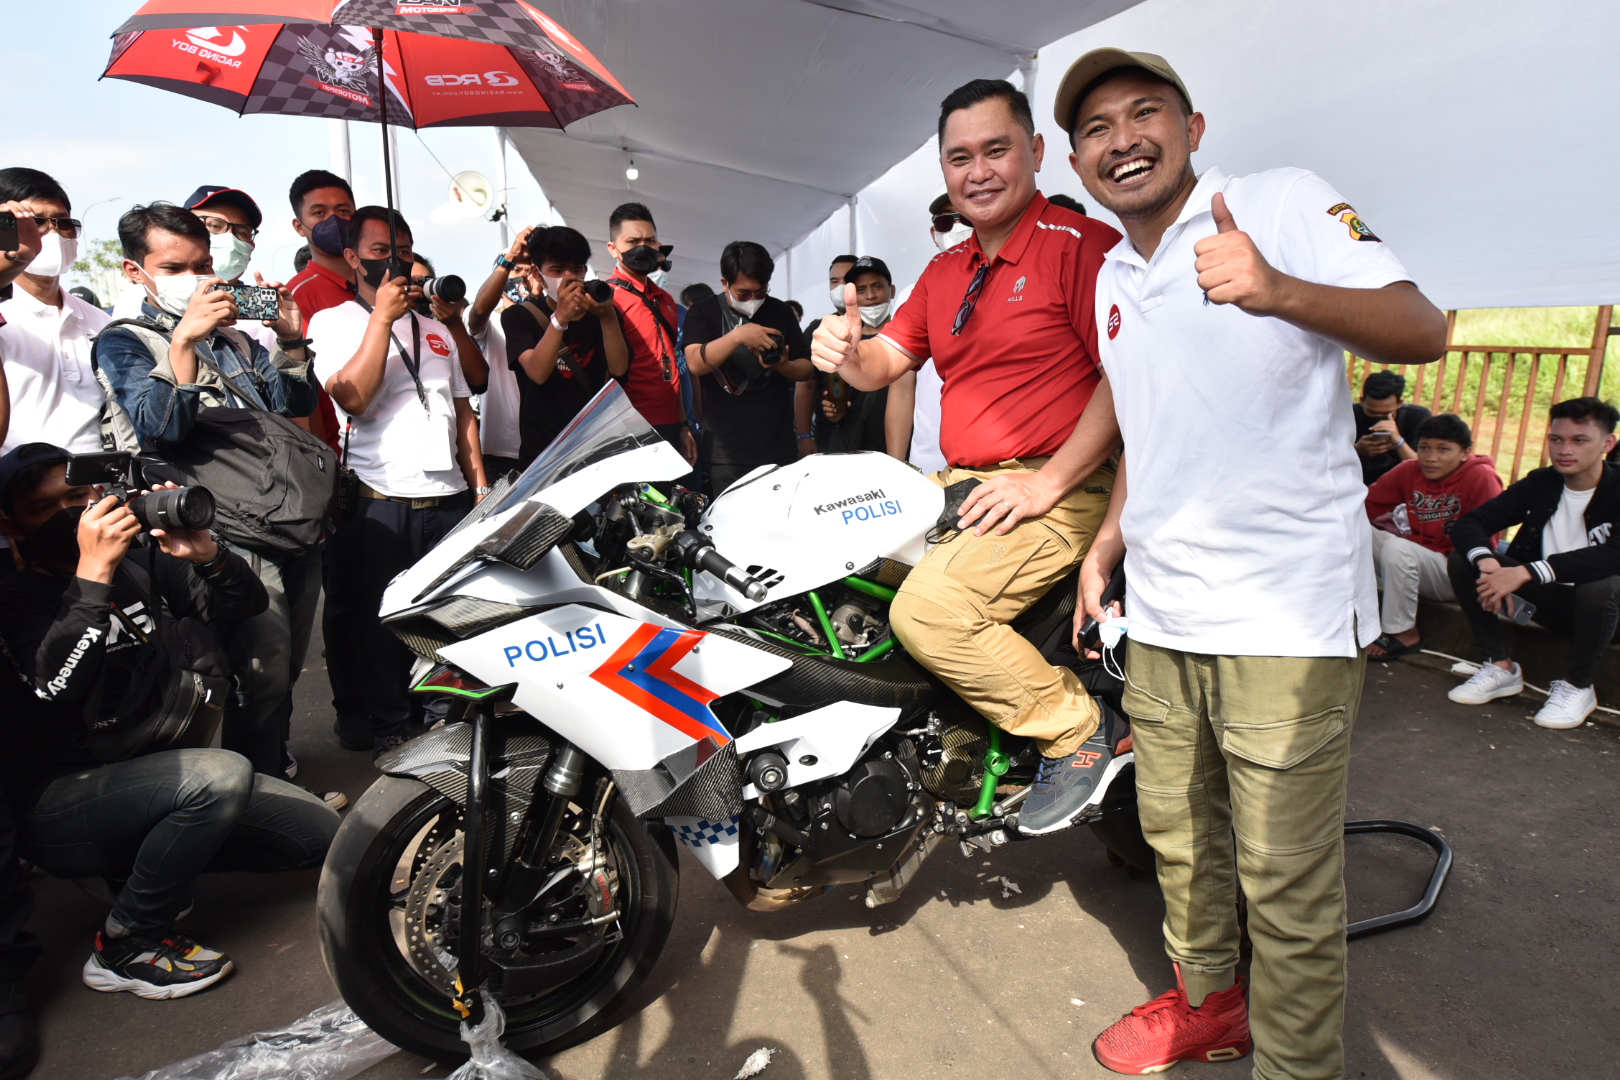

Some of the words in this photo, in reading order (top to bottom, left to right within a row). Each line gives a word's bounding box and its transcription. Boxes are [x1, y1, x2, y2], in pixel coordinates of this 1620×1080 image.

[813, 488, 886, 516] Kawasaki
[841, 499, 903, 525] POLISI
[46, 626, 102, 697] Kennedy
[503, 622, 607, 668] POLISI
[596, 874, 612, 910] brembo
